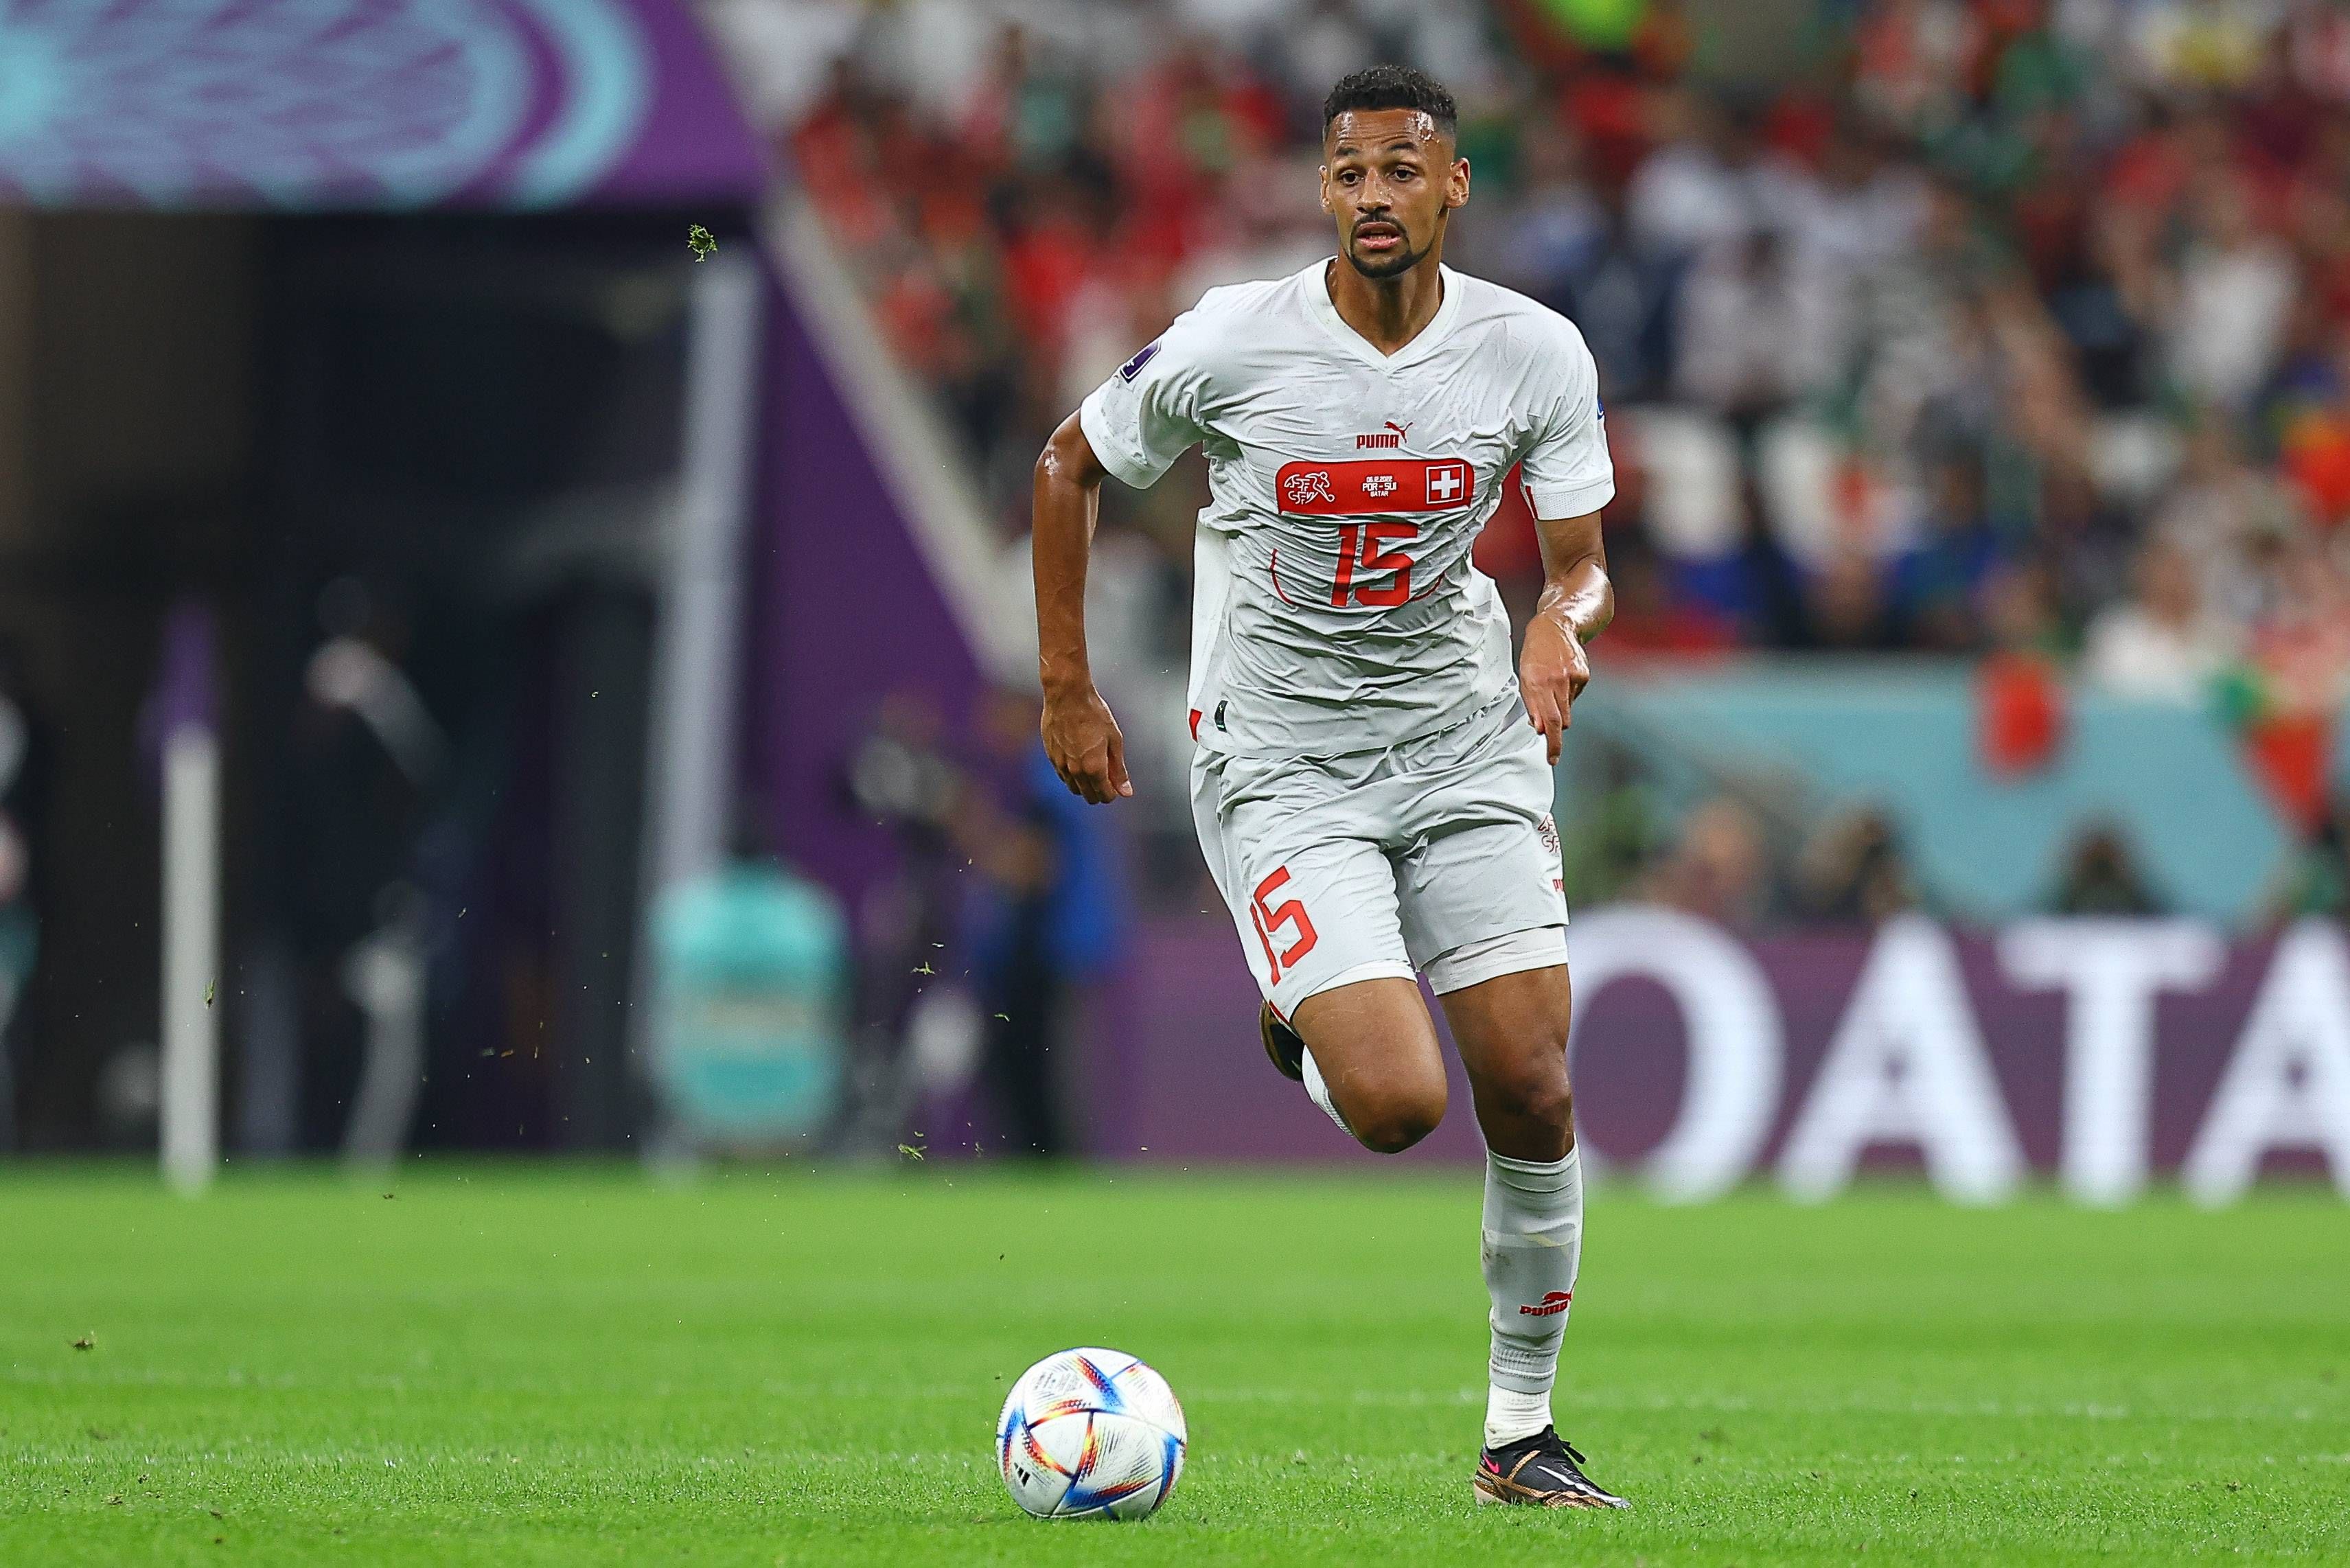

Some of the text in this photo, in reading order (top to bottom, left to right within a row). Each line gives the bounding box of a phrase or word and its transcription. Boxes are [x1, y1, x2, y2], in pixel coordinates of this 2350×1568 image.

[1356, 435, 1399, 450] PUMA
[1362, 482, 1379, 492] POR
[1384, 482, 1397, 491] SUI
[1330, 522, 1420, 607] 15
[1249, 864, 1318, 987] 15
[1519, 1299, 1568, 1317] PUMA
